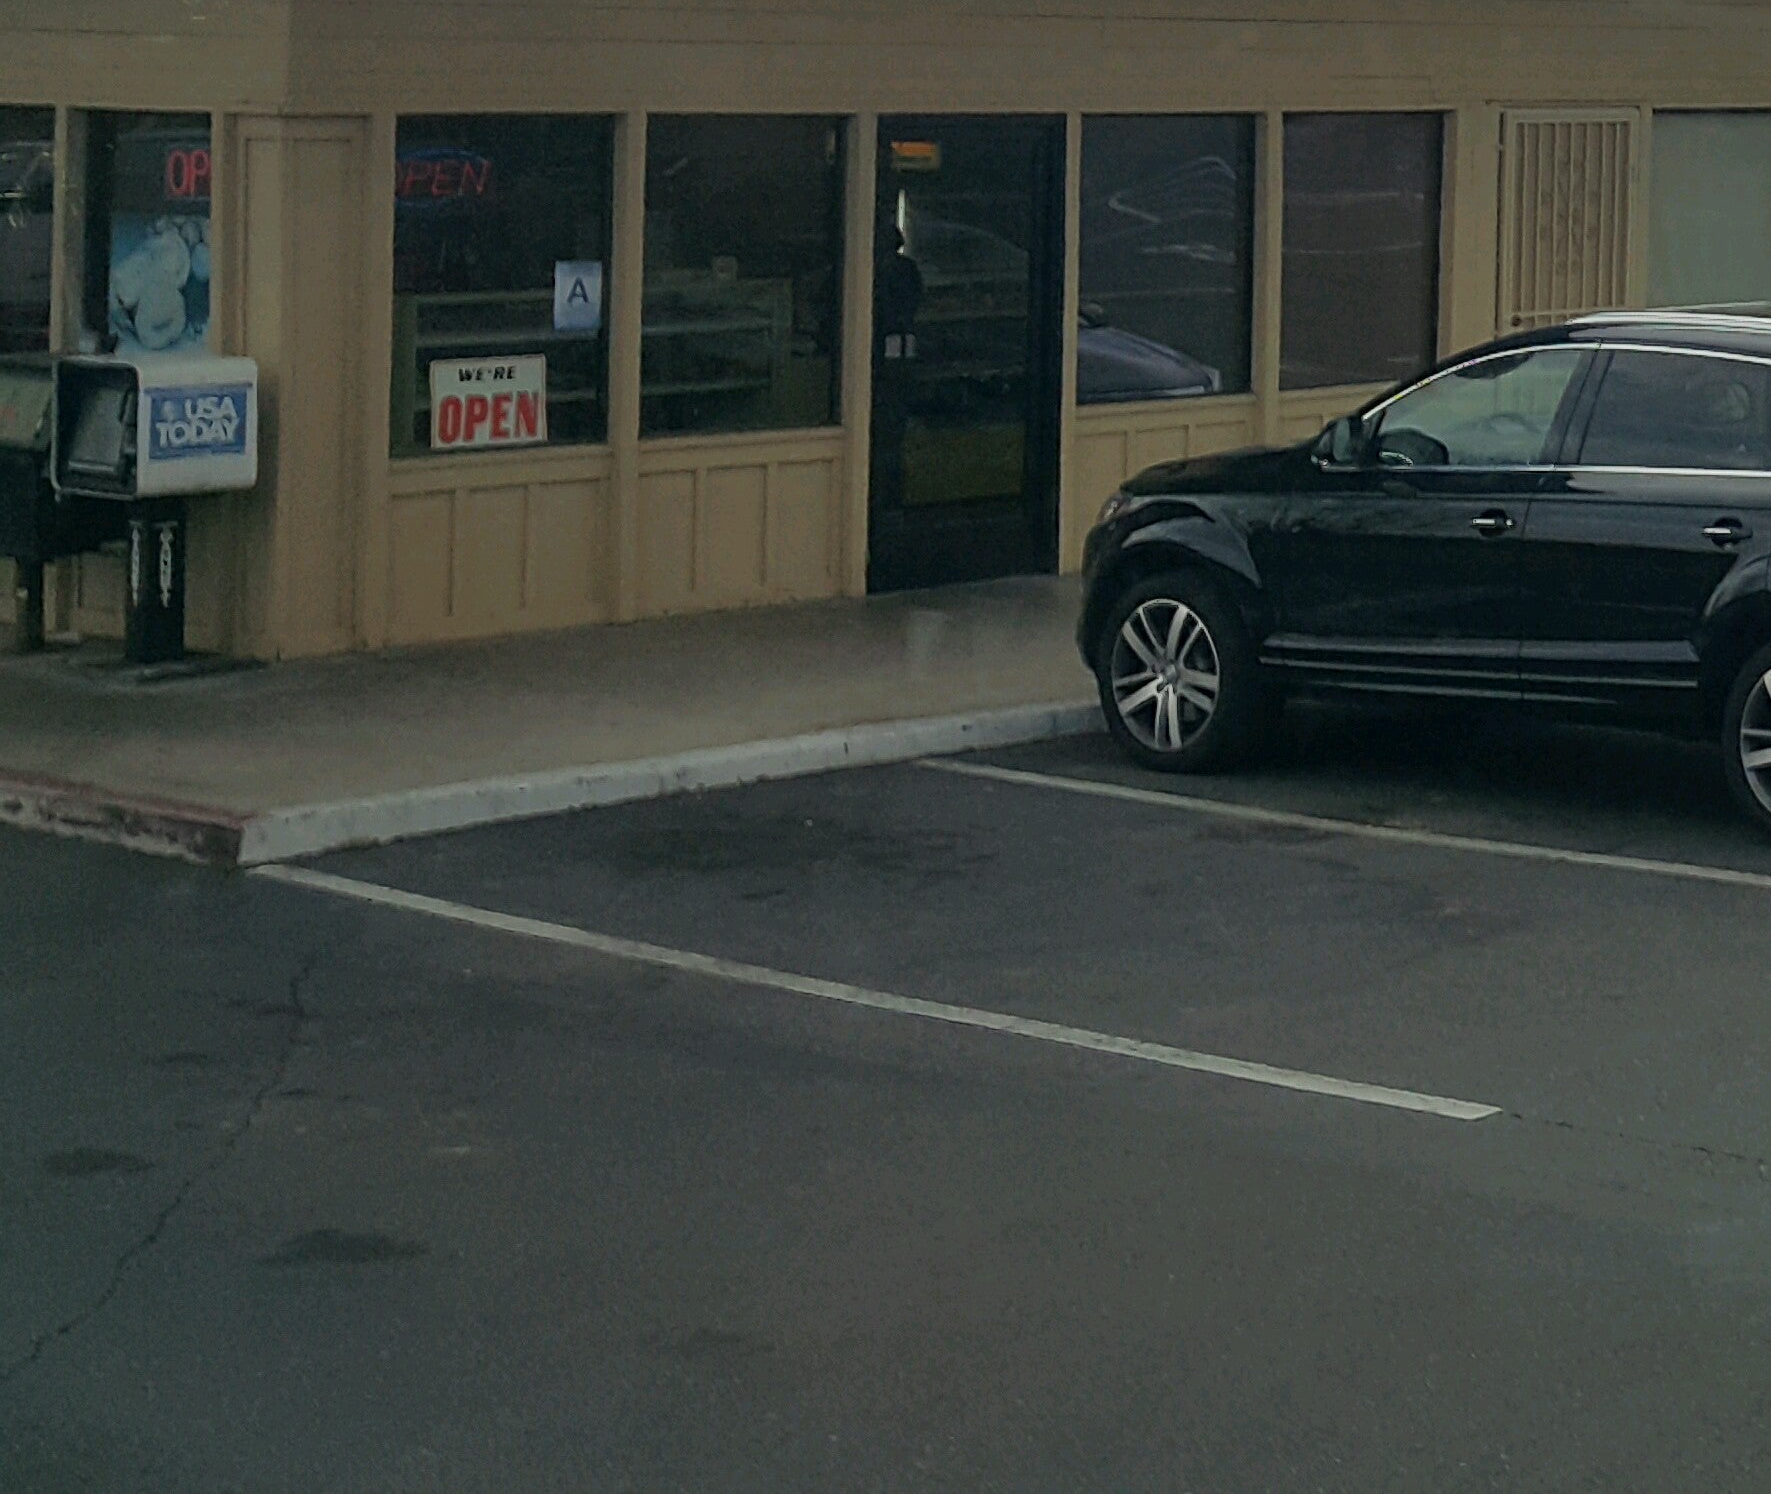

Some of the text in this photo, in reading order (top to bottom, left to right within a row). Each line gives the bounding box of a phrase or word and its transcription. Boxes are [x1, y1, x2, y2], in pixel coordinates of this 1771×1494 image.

[166, 149, 211, 198] OP
[396, 158, 492, 196] PEN
[566, 276, 590, 304] A
[184, 395, 238, 421] USA
[437, 389, 540, 444] OPEN
[155, 417, 240, 448] TODAY
